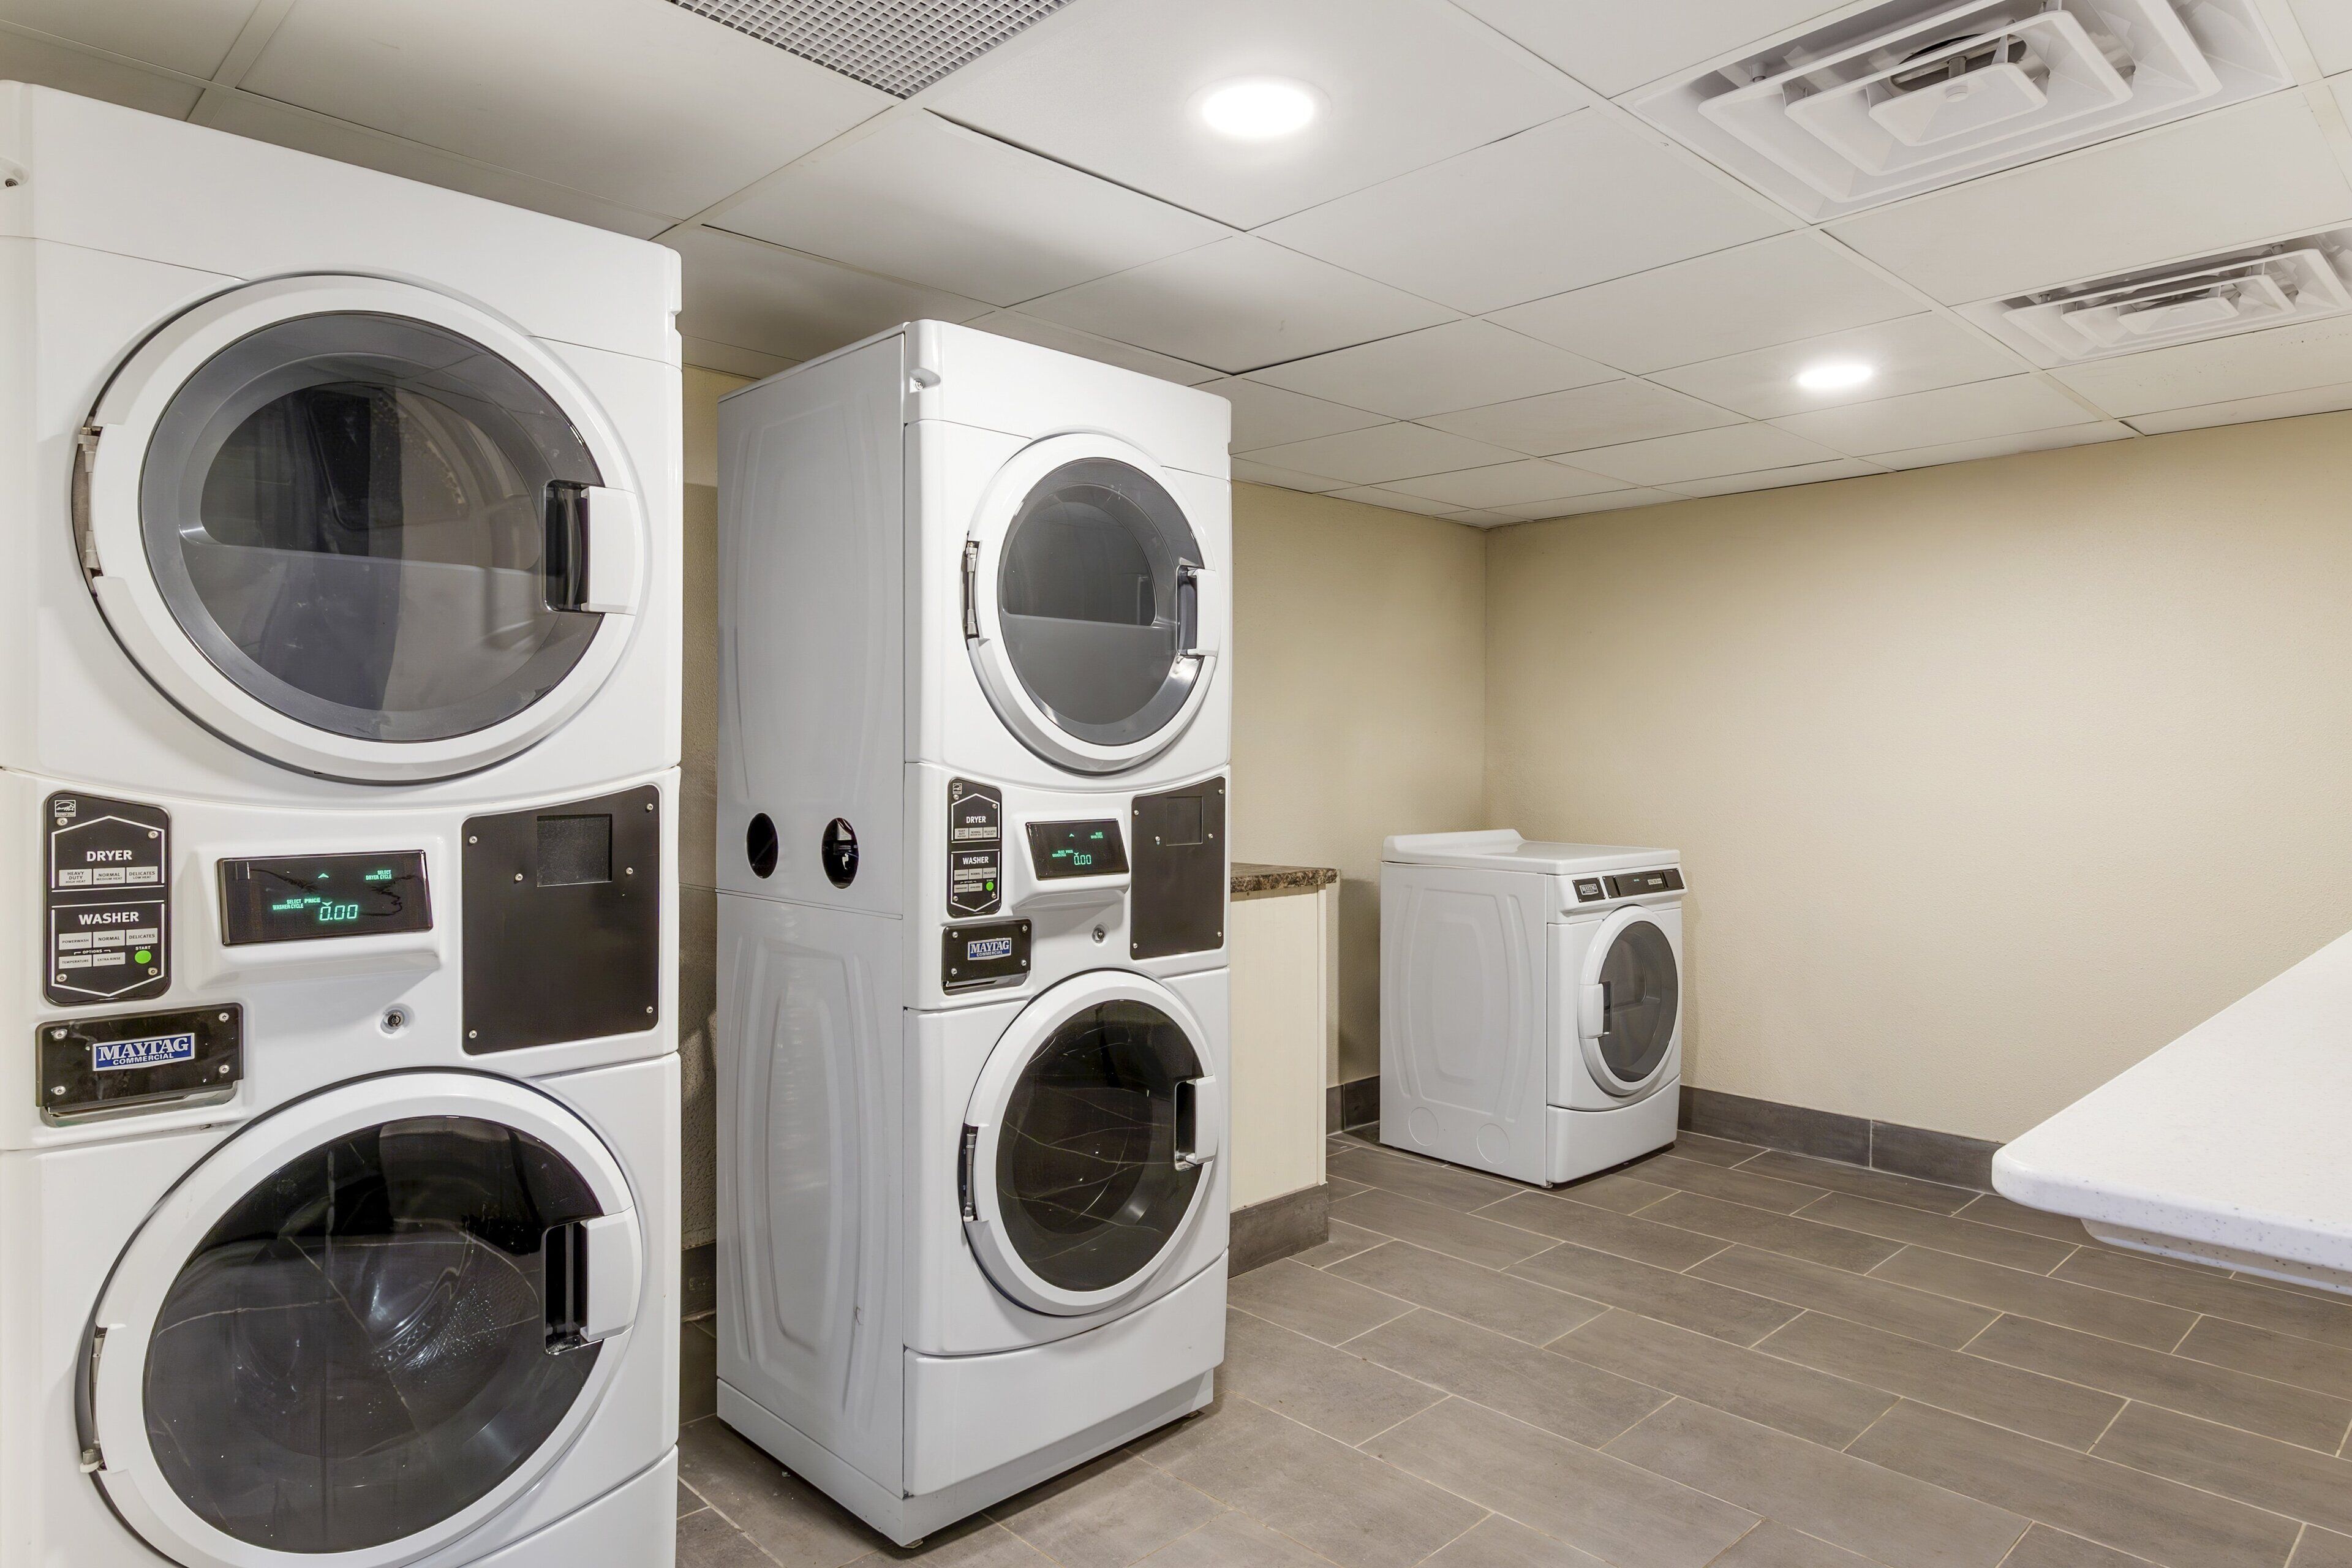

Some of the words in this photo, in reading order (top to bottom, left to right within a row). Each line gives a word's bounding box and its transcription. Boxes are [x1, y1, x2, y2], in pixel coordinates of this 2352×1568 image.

[86, 850, 132, 862] DRYER
[962, 856, 989, 865] WASHER
[78, 911, 139, 925] WASHER
[319, 905, 358, 921] 0.00
[970, 941, 1009, 954] MAYTAG
[98, 1037, 189, 1061] MAYTAG
[113, 1052, 174, 1066] COMMERCIAL
